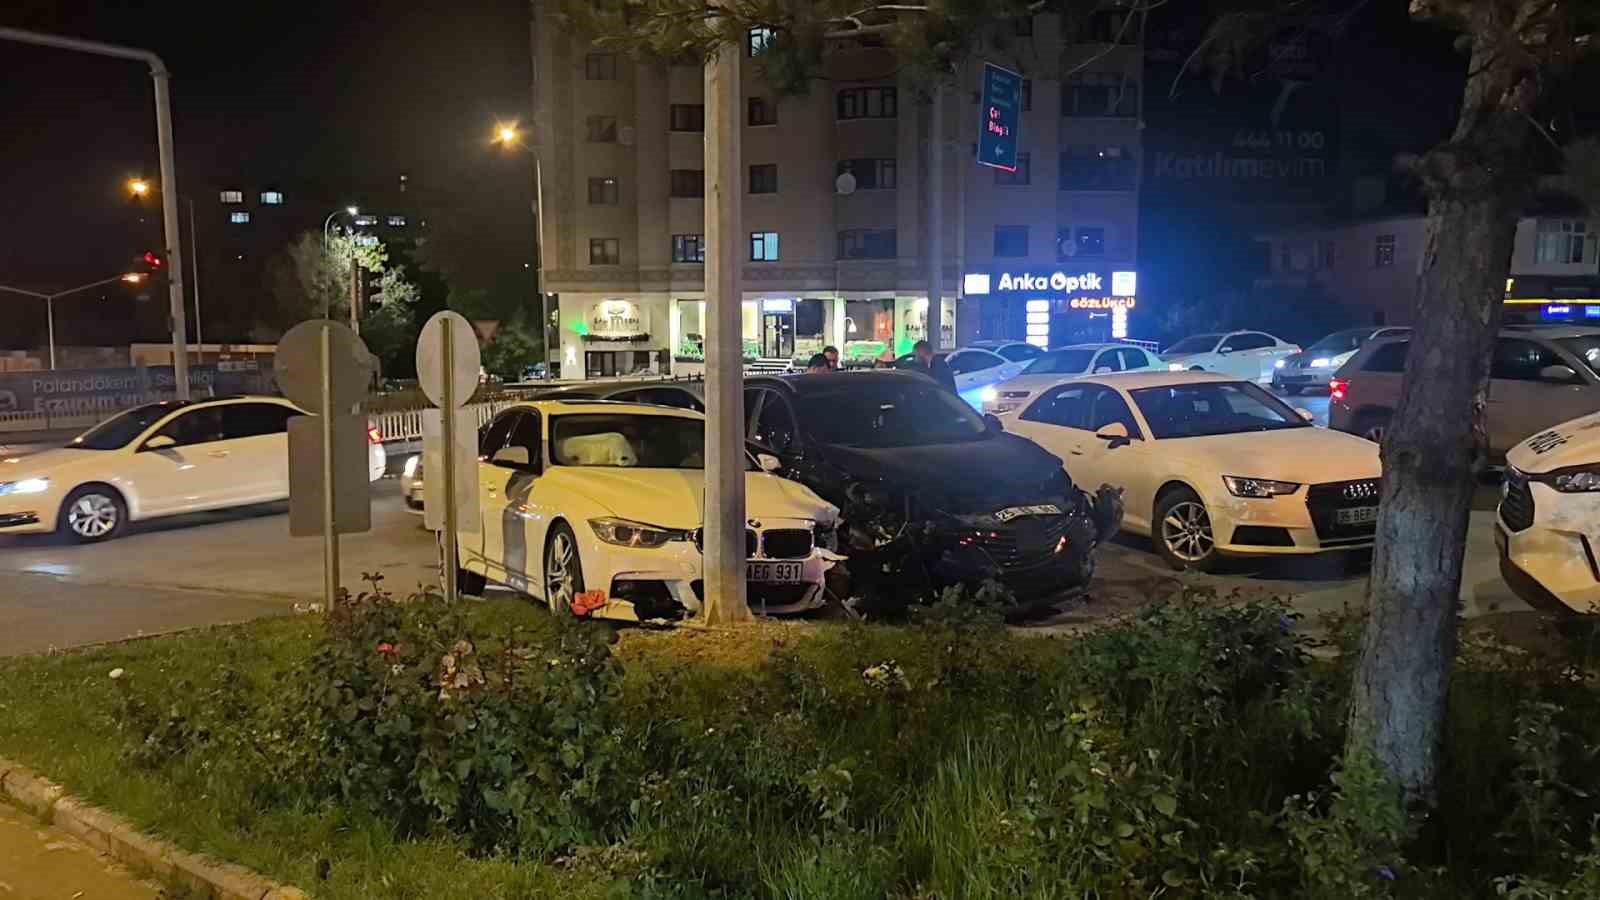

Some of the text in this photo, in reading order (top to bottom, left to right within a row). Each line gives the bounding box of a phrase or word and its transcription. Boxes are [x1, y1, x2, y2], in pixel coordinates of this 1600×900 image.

[1298, 131, 1325, 148] 00
[998, 271, 1102, 293] Anka Optik
[776, 564, 800, 579] 931
